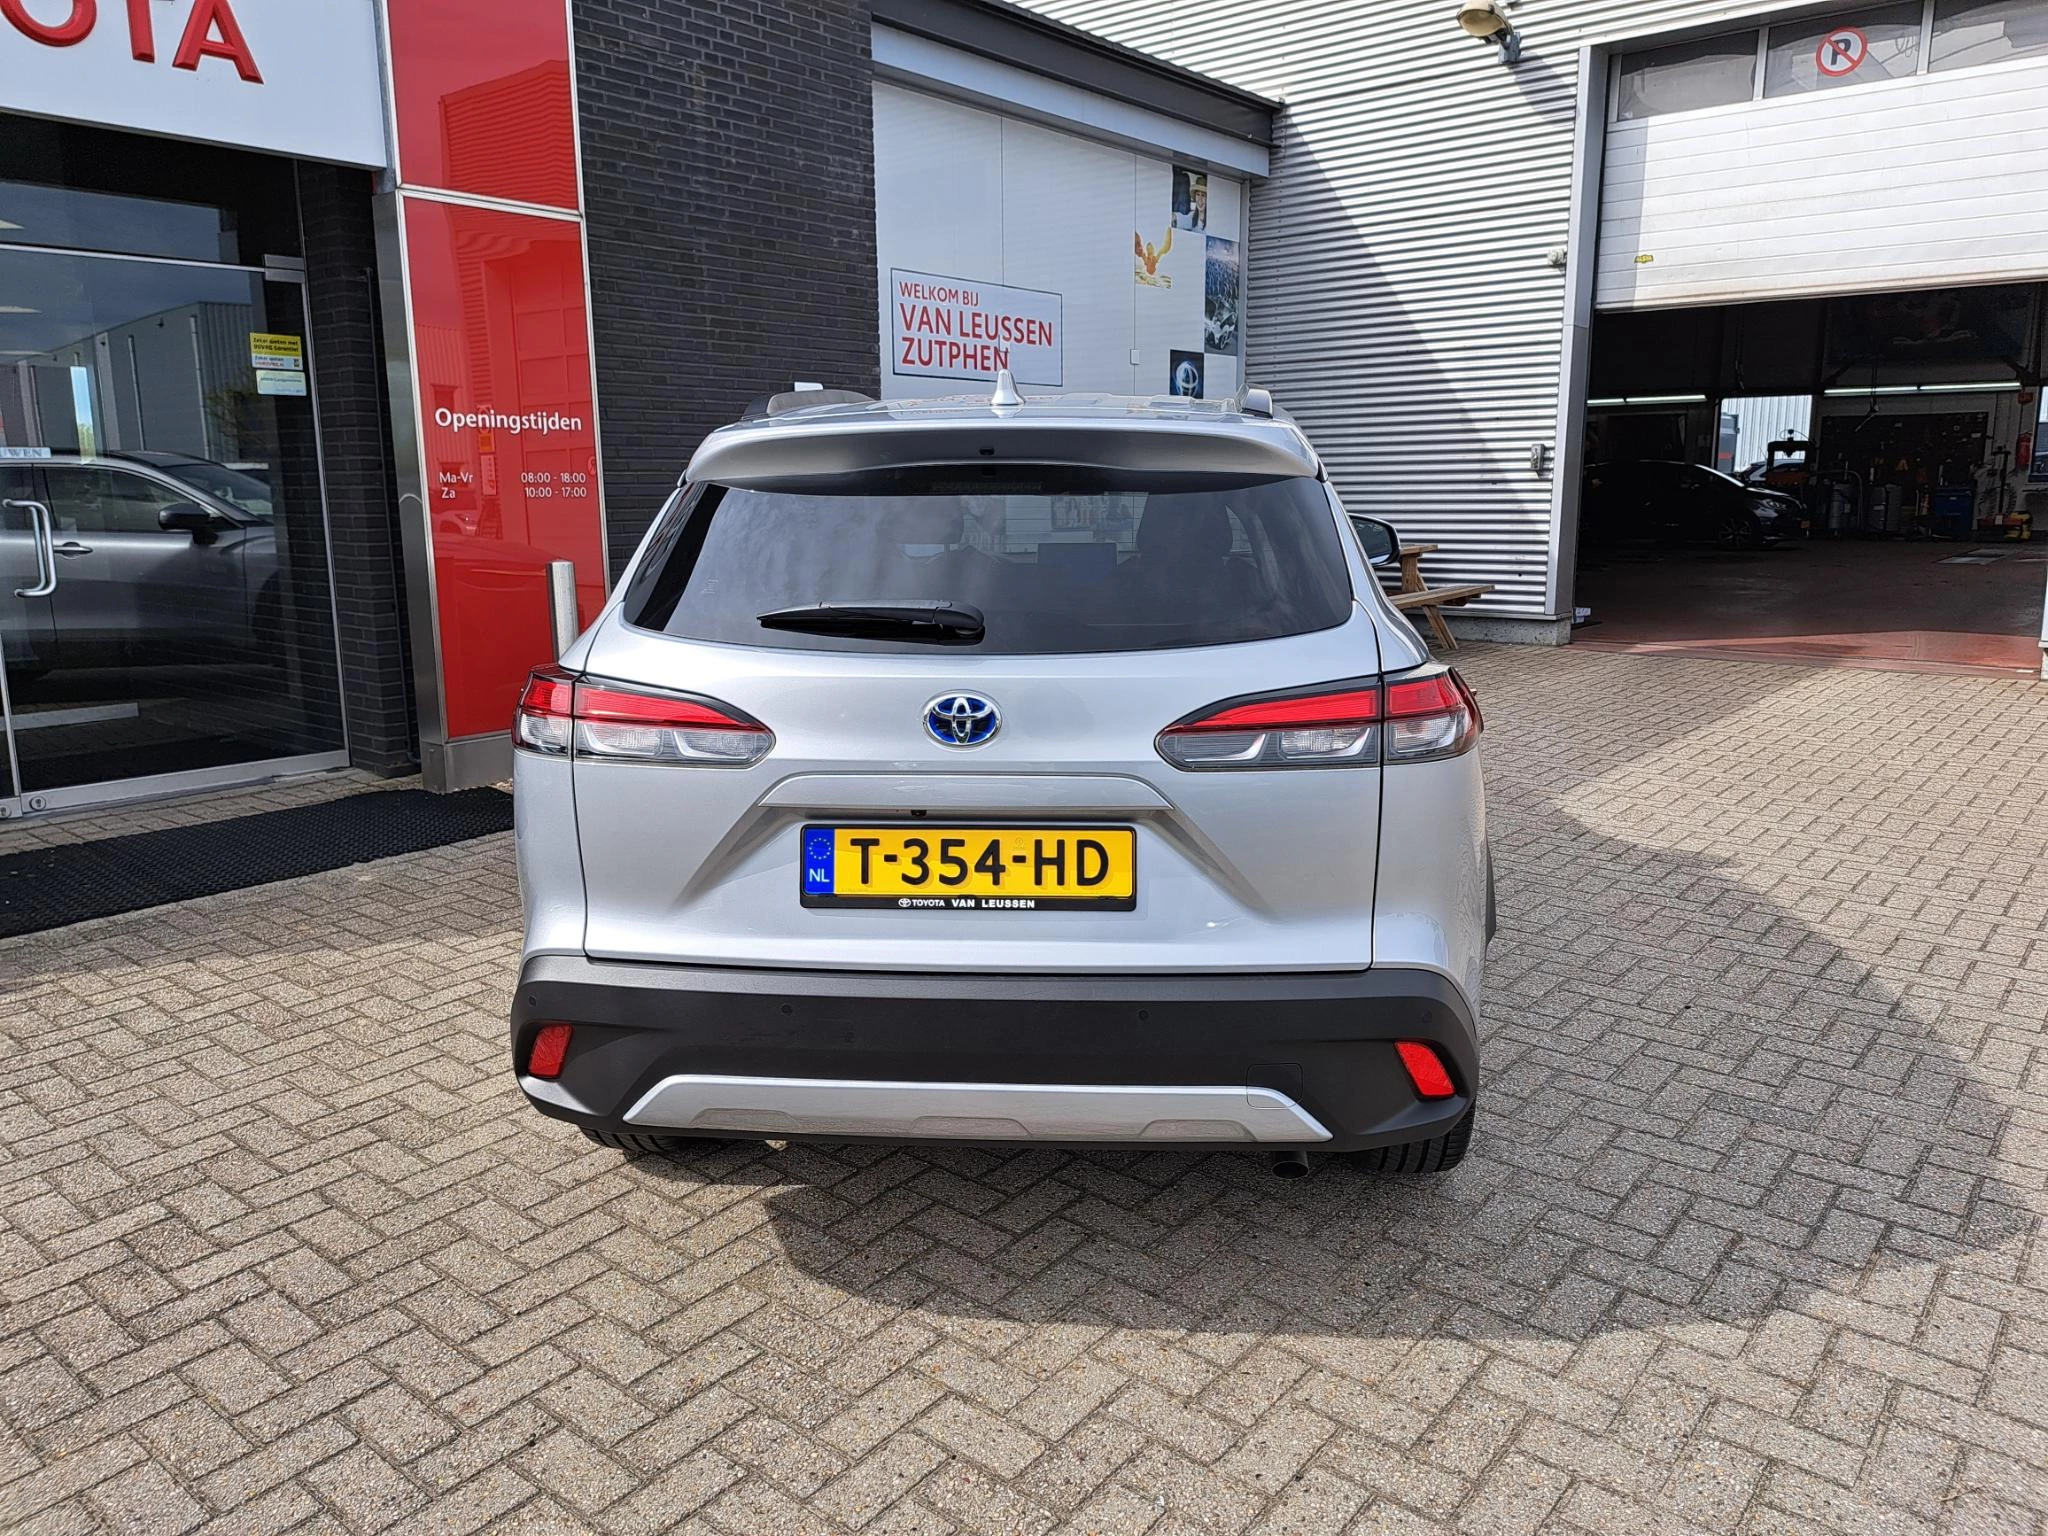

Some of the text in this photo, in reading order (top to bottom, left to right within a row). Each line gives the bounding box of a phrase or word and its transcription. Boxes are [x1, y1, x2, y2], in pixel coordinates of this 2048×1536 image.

[899, 281, 979, 306] WELKOM BIJ
[899, 303, 1053, 347] VAN LEUSSEN
[902, 336, 1009, 371] ZUTPHEN
[435, 408, 582, 435] Openingstijden
[439, 472, 474, 484] Ma-Vr
[521, 472, 551, 483] 08:00
[560, 472, 586, 483] 18:00
[441, 487, 456, 499] Za
[525, 487, 552, 497] 10:00
[562, 487, 587, 497] 17:00
[850, 837, 1109, 887] T-354-HD
[808, 867, 830, 883] NL
[912, 899, 1036, 908] TOYOTA VAN LEUSSEN
